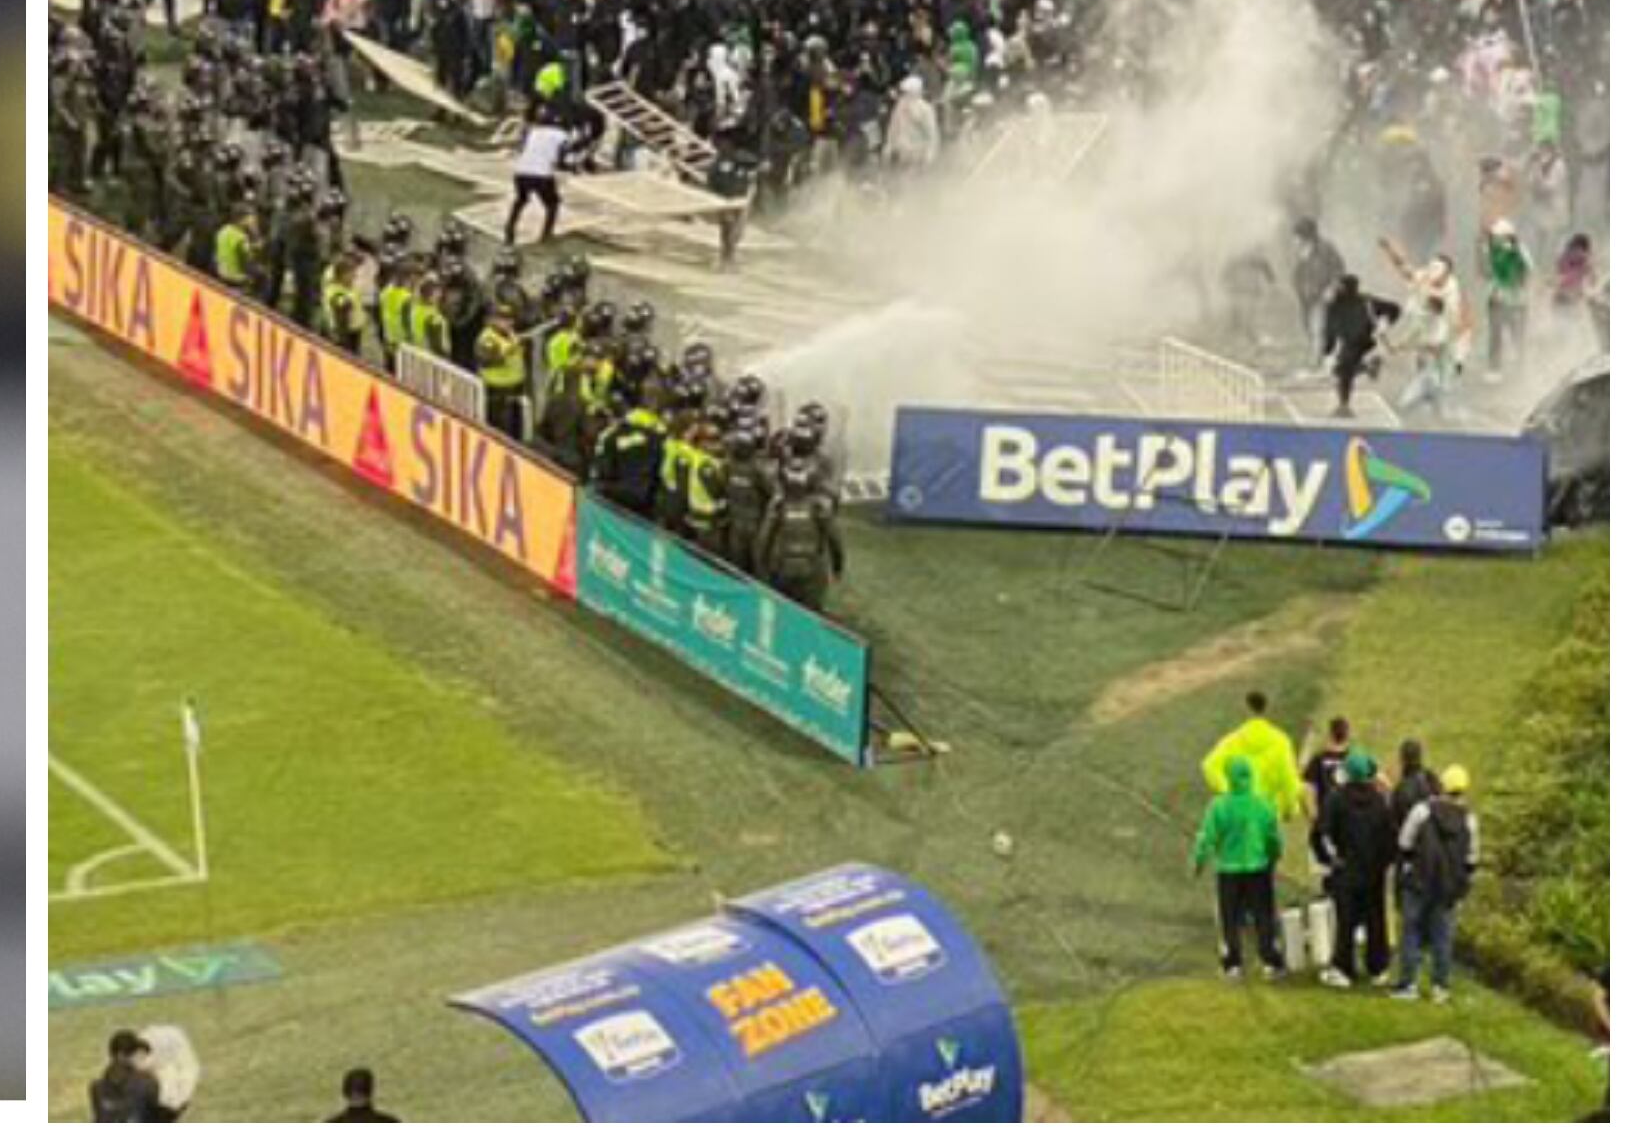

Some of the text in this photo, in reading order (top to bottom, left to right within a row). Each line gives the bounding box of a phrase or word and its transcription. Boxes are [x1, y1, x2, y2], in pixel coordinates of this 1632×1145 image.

[64, 219, 158, 355] SIKA
[228, 303, 330, 446] SIKA
[411, 403, 528, 559] SIKA
[978, 423, 1330, 537] BetPlay
